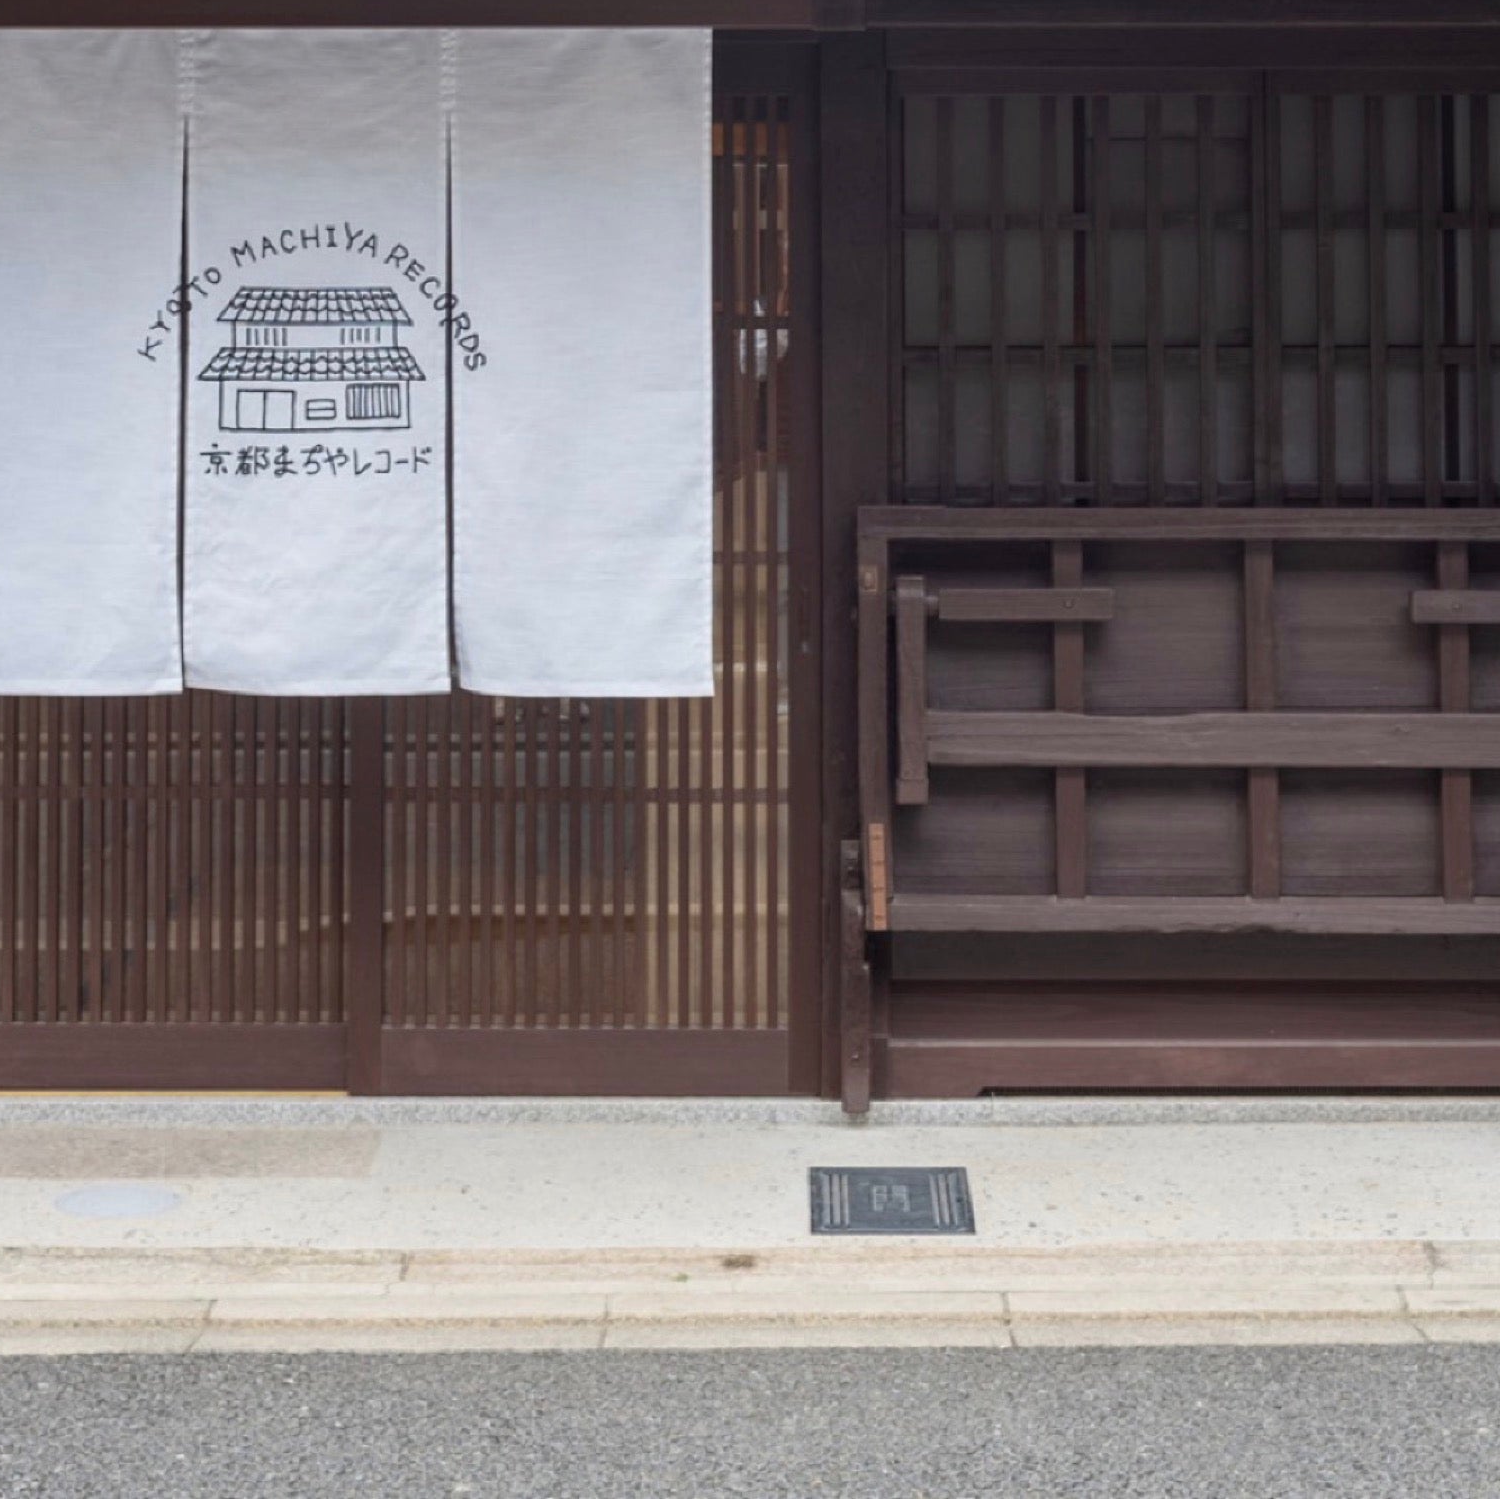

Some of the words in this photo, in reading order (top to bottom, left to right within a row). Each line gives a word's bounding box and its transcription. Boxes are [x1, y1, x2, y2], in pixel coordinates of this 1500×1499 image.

[137, 266, 222, 362] KYOTO
[230, 221, 379, 268] MACHIYA
[383, 243, 488, 373] RECORDS
